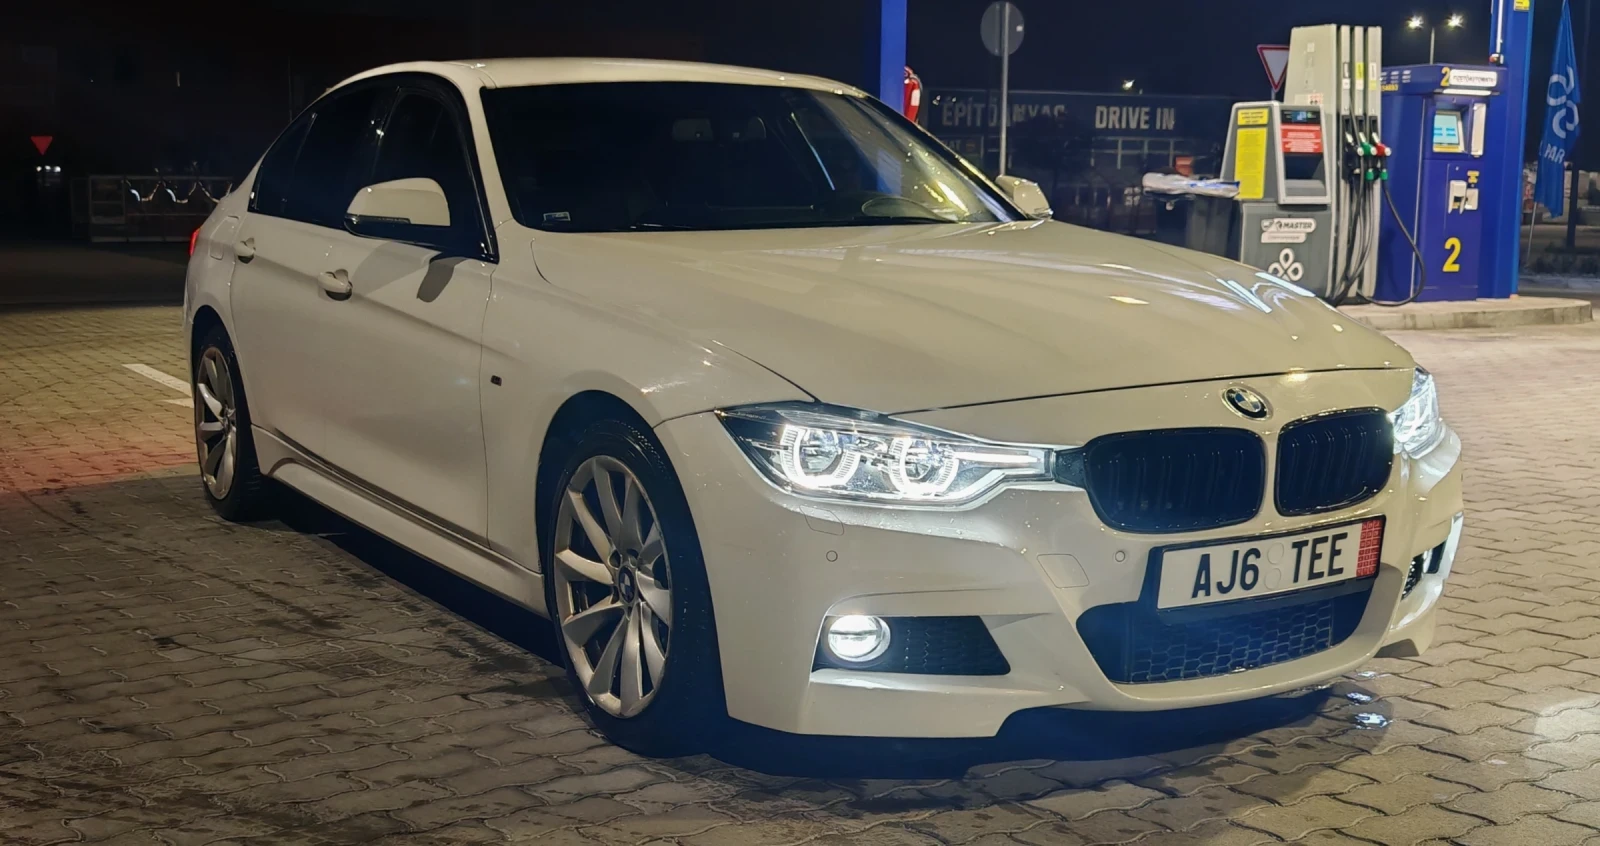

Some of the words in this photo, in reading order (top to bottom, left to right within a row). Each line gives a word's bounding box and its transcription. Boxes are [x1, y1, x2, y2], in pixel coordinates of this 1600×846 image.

[1440, 67, 1451, 87] 2
[1095, 105, 1150, 129] DRIVE
[1155, 107, 1175, 130] IN
[1283, 221, 1313, 229] MASTER
[1442, 237, 1461, 272] 2
[1191, 547, 1261, 599] AJ6
[1292, 532, 1348, 584] TEE
